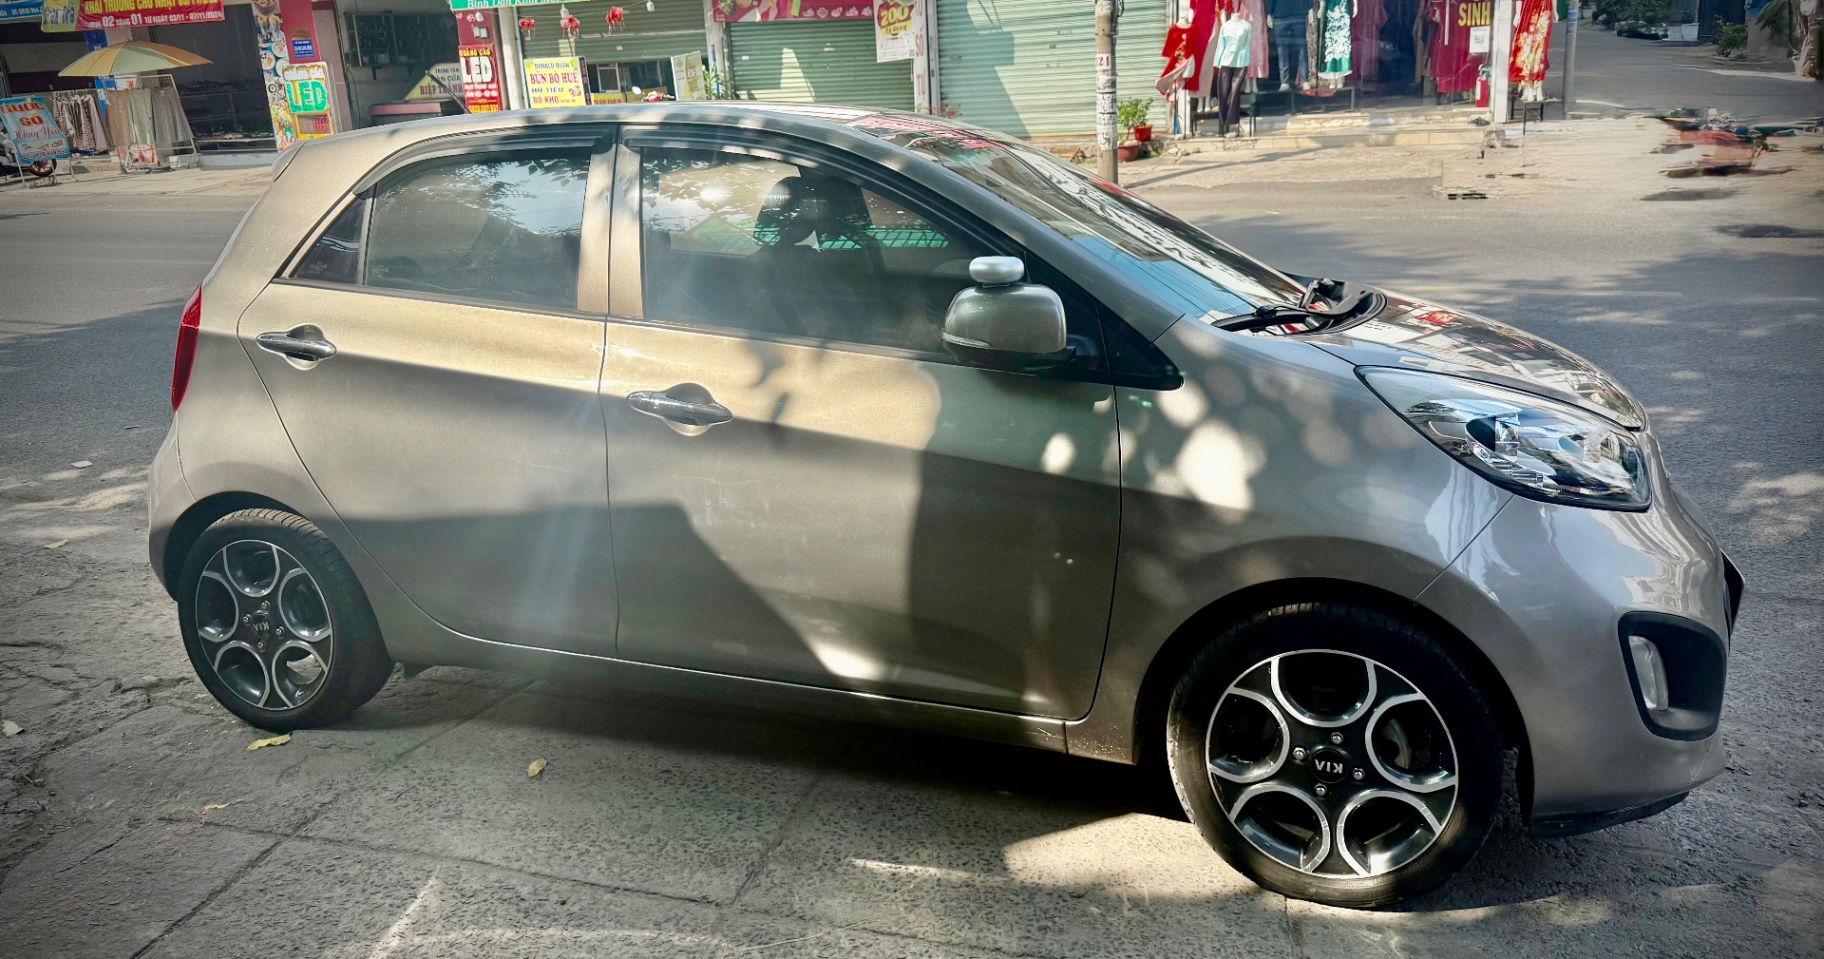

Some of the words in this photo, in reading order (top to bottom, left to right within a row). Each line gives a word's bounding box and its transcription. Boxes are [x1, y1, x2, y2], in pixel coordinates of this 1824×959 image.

[102, 16, 115, 27] 02
[131, 13, 143, 25] 01
[881, 6, 909, 27] 200
[1458, 2, 1491, 26] SINH
[1096, 55, 1110, 66] 21
[460, 56, 493, 83] LED
[530, 70, 548, 84] BÚN
[420, 82, 437, 96] HIỆP
[285, 80, 328, 113] LED
[253, 621, 270, 632] KIA
[1314, 759, 1344, 774] KIA
